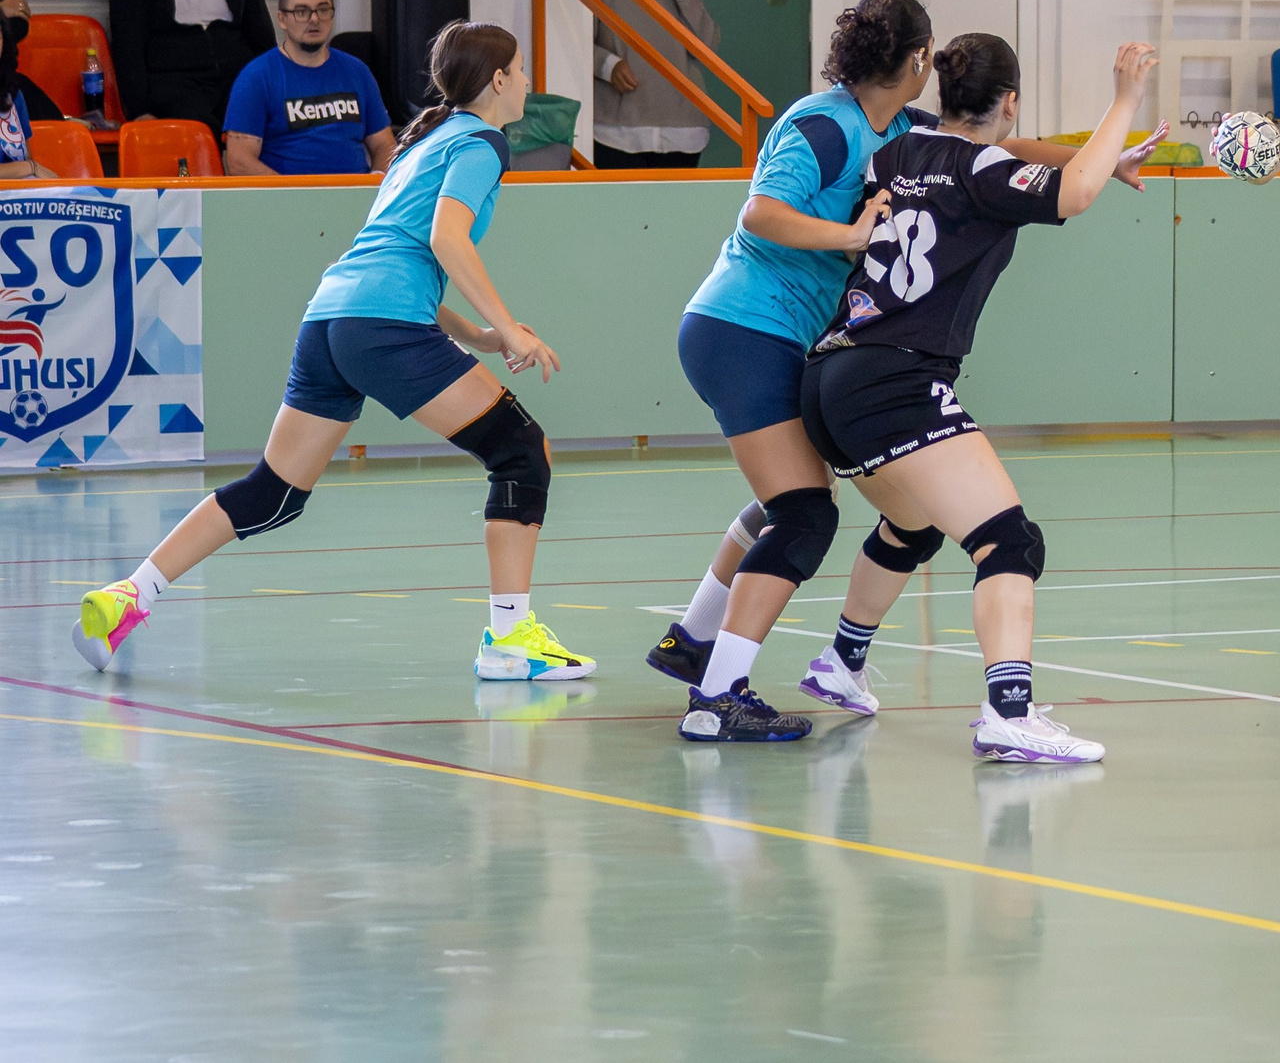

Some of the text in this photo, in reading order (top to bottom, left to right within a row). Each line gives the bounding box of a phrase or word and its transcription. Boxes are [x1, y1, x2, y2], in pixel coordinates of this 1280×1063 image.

[286, 100, 360, 122] Kempa
[48, 200, 123, 221] ORĂȘENESC
[890, 440, 919, 456] Kempa
[927, 426, 956, 441] Kempa
